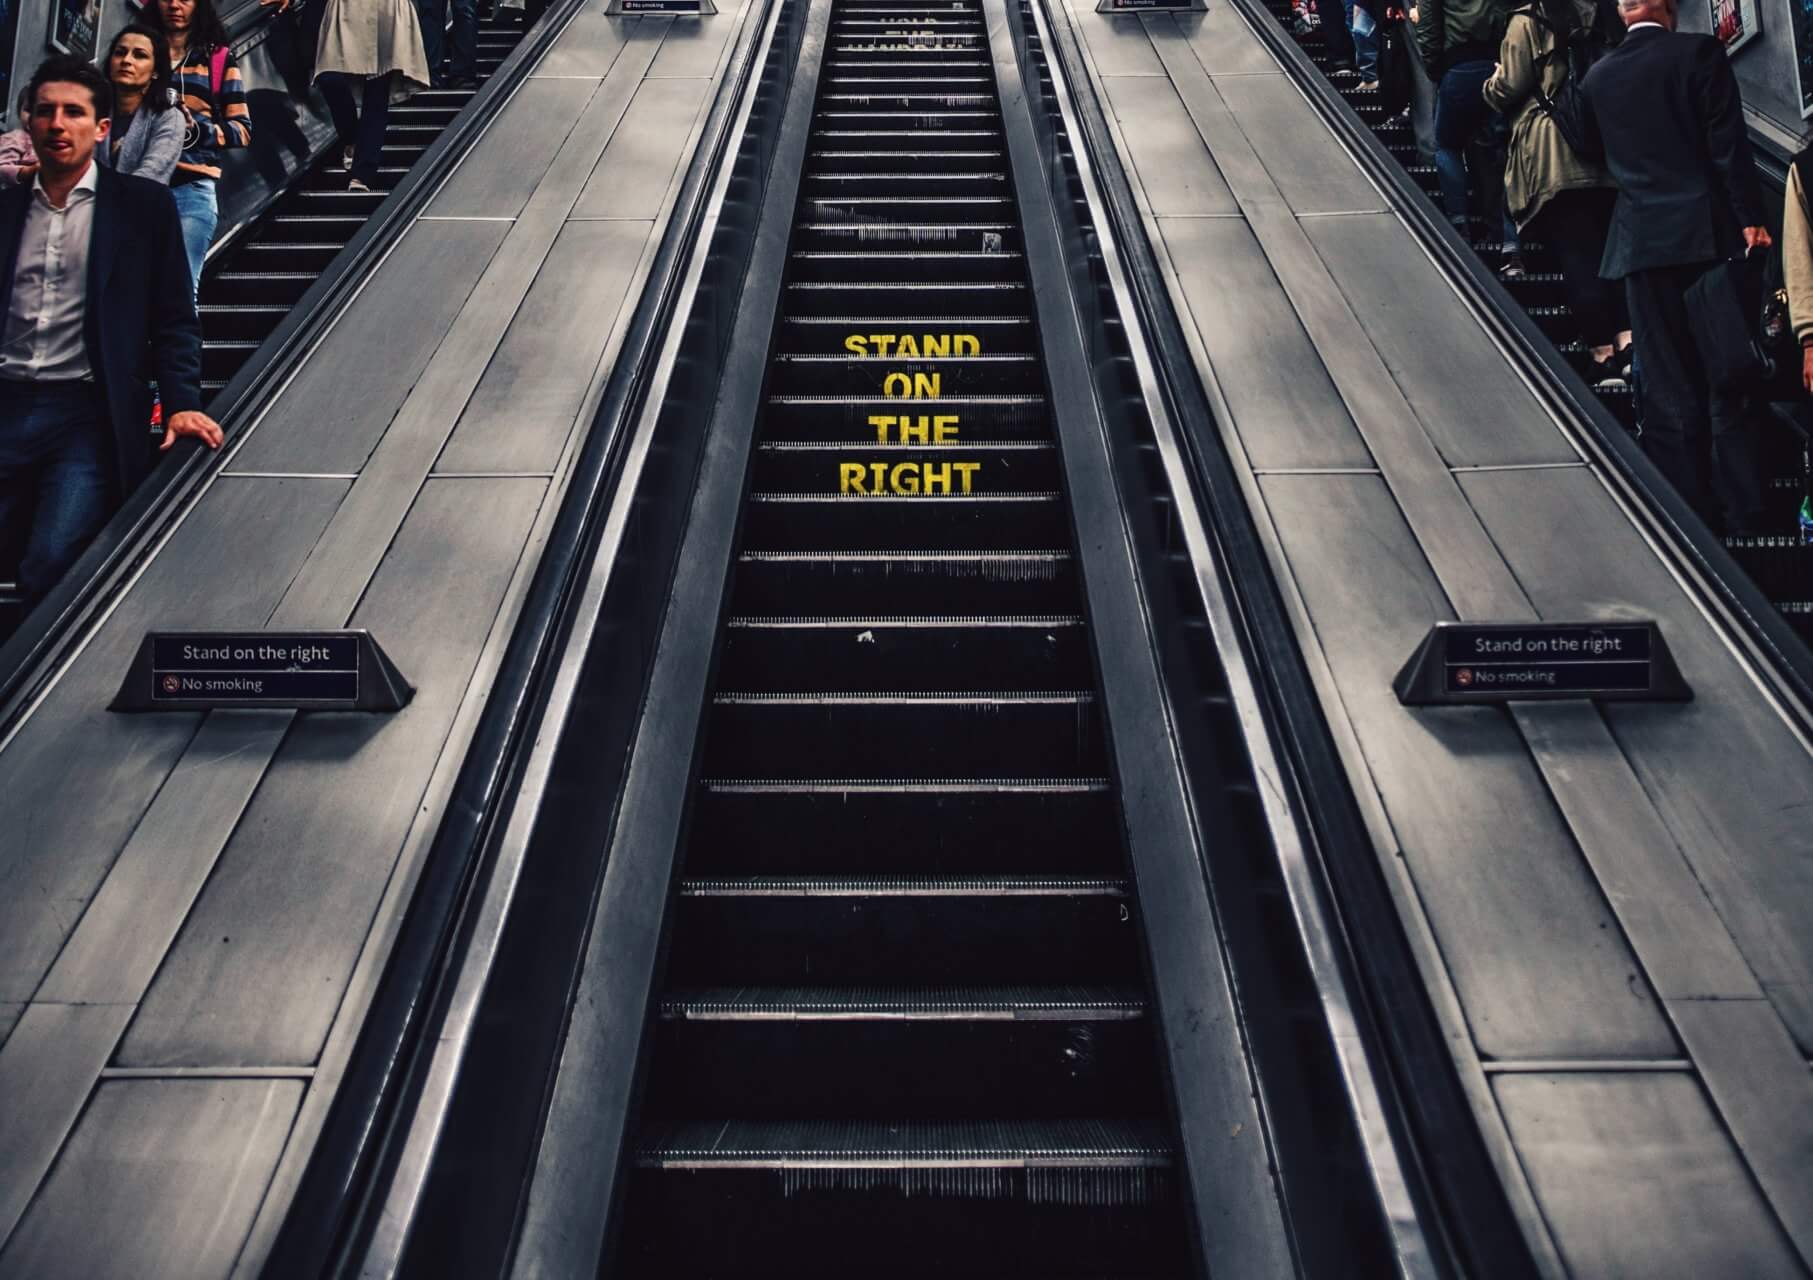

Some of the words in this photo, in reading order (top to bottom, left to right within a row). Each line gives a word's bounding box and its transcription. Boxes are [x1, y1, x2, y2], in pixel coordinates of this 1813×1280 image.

[844, 334, 981, 358] STAND
[884, 372, 941, 400] ON
[868, 415, 960, 444] THE
[840, 462, 981, 496] RIGHT
[183, 644, 231, 660] Stand
[233, 648, 255, 660] on
[257, 644, 287, 660] the
[290, 644, 331, 664] right
[1475, 637, 1523, 653] Stand
[1526, 640, 1548, 652] on
[1550, 636, 1580, 652] the
[1583, 636, 1622, 655] right
[182, 677, 202, 690] No
[205, 677, 263, 694] smoking
[1475, 671, 1497, 683] No
[1499, 670, 1556, 686] smoking
